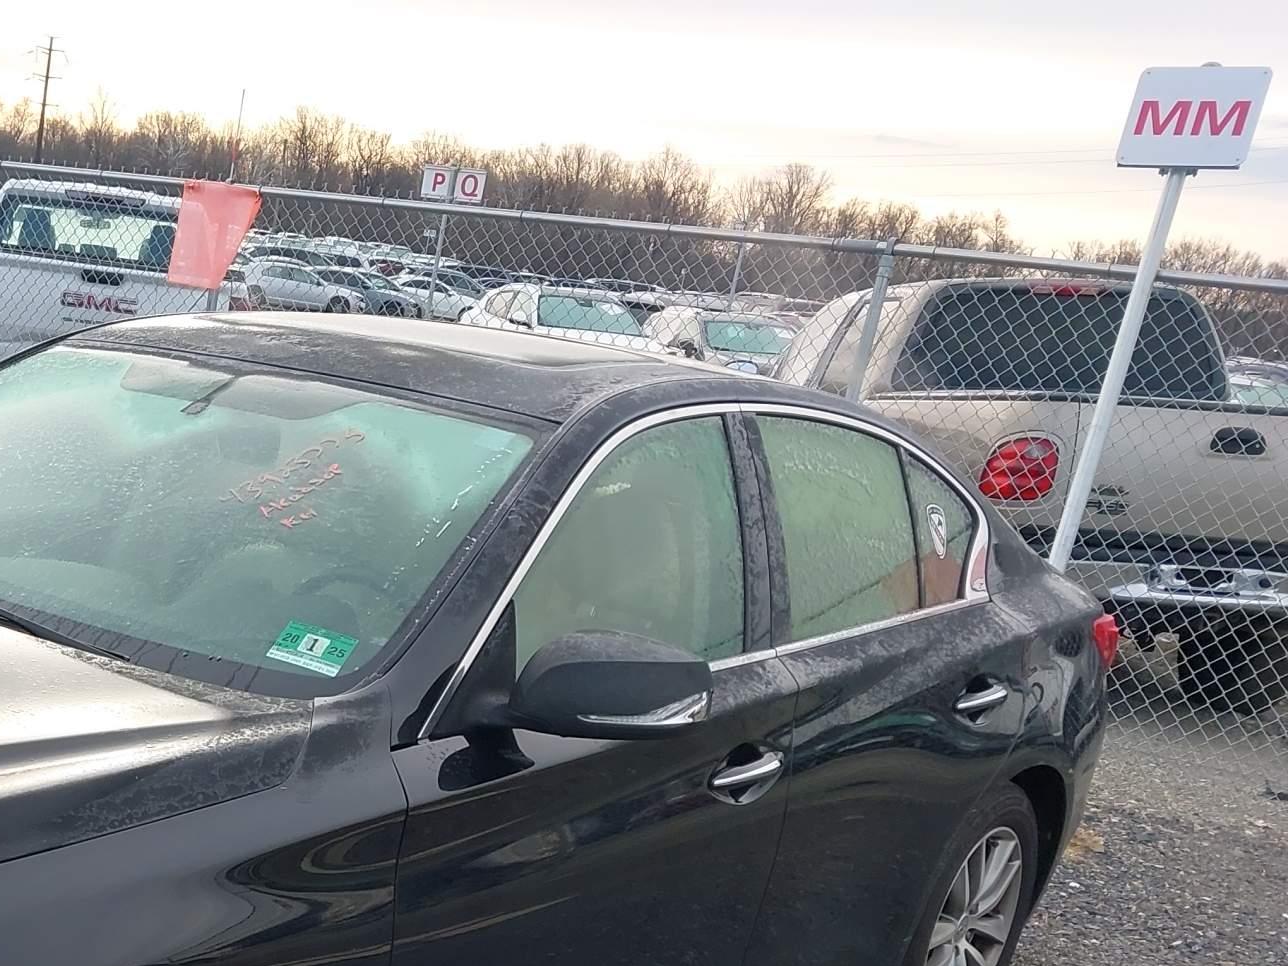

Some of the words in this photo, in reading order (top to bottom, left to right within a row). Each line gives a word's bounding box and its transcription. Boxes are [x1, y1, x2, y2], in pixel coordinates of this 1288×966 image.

[1133, 100, 1252, 136] MM
[432, 172, 446, 192] P
[460, 174, 478, 197] Q
[60, 291, 138, 314] GMC
[282, 632, 300, 644] 20
[306, 638, 320, 652] 1
[327, 646, 347, 658] 25
